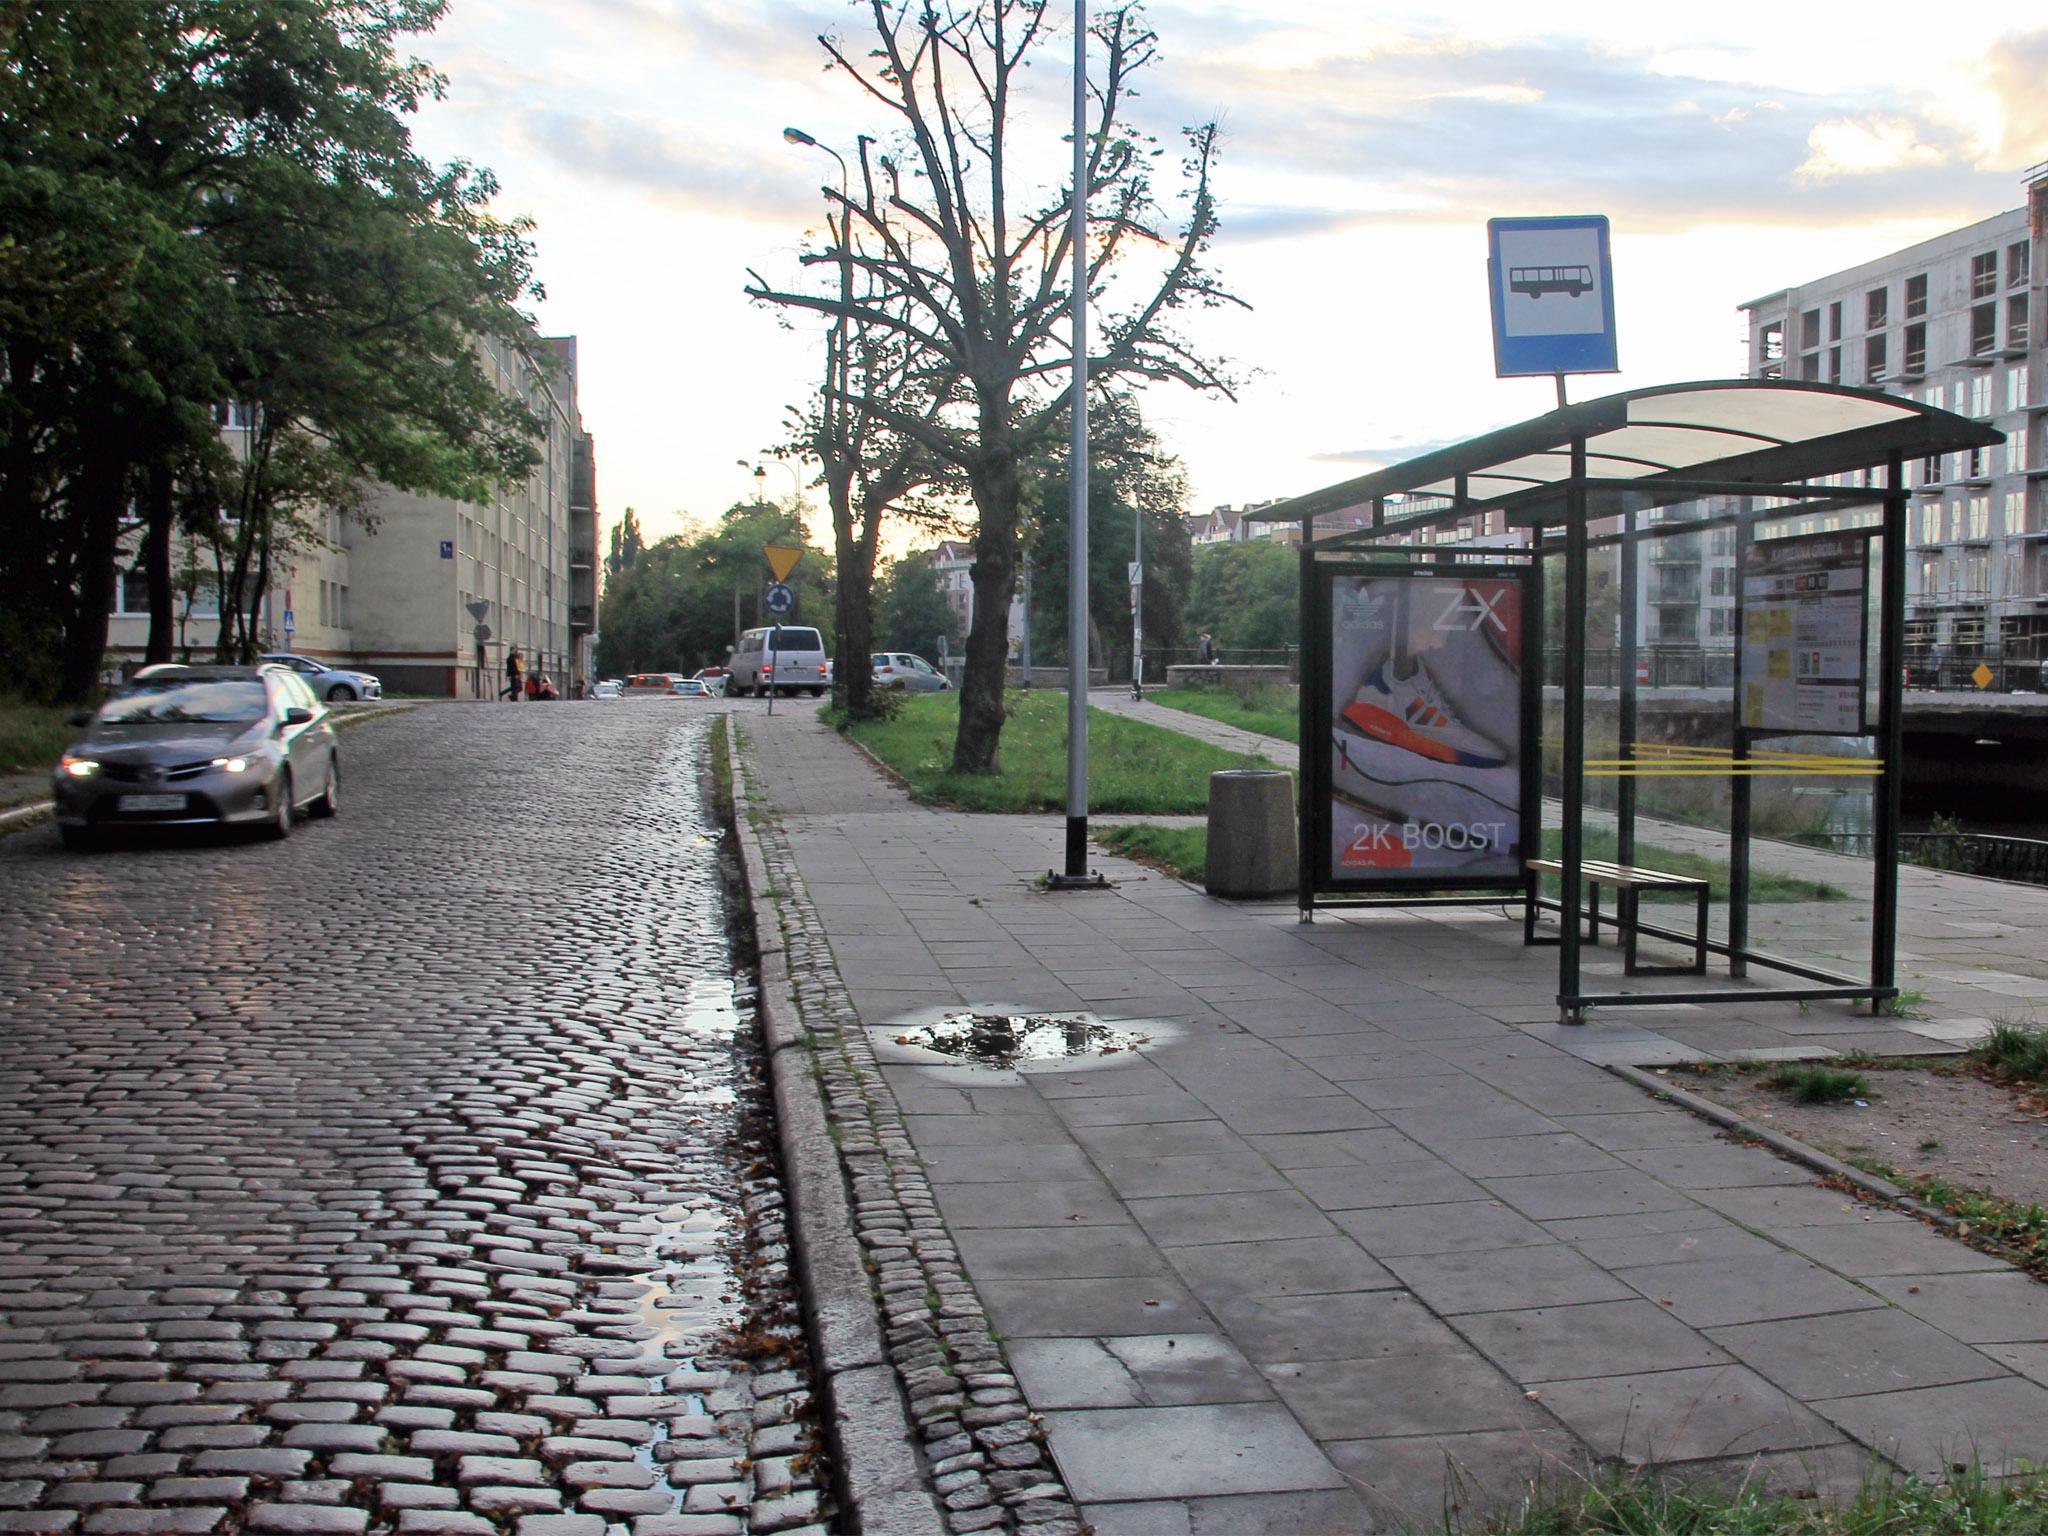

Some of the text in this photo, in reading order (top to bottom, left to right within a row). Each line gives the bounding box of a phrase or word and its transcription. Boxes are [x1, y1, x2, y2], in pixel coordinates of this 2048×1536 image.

[1433, 588, 1507, 631] ZX
[1353, 822, 1505, 850] 2K BOOST
